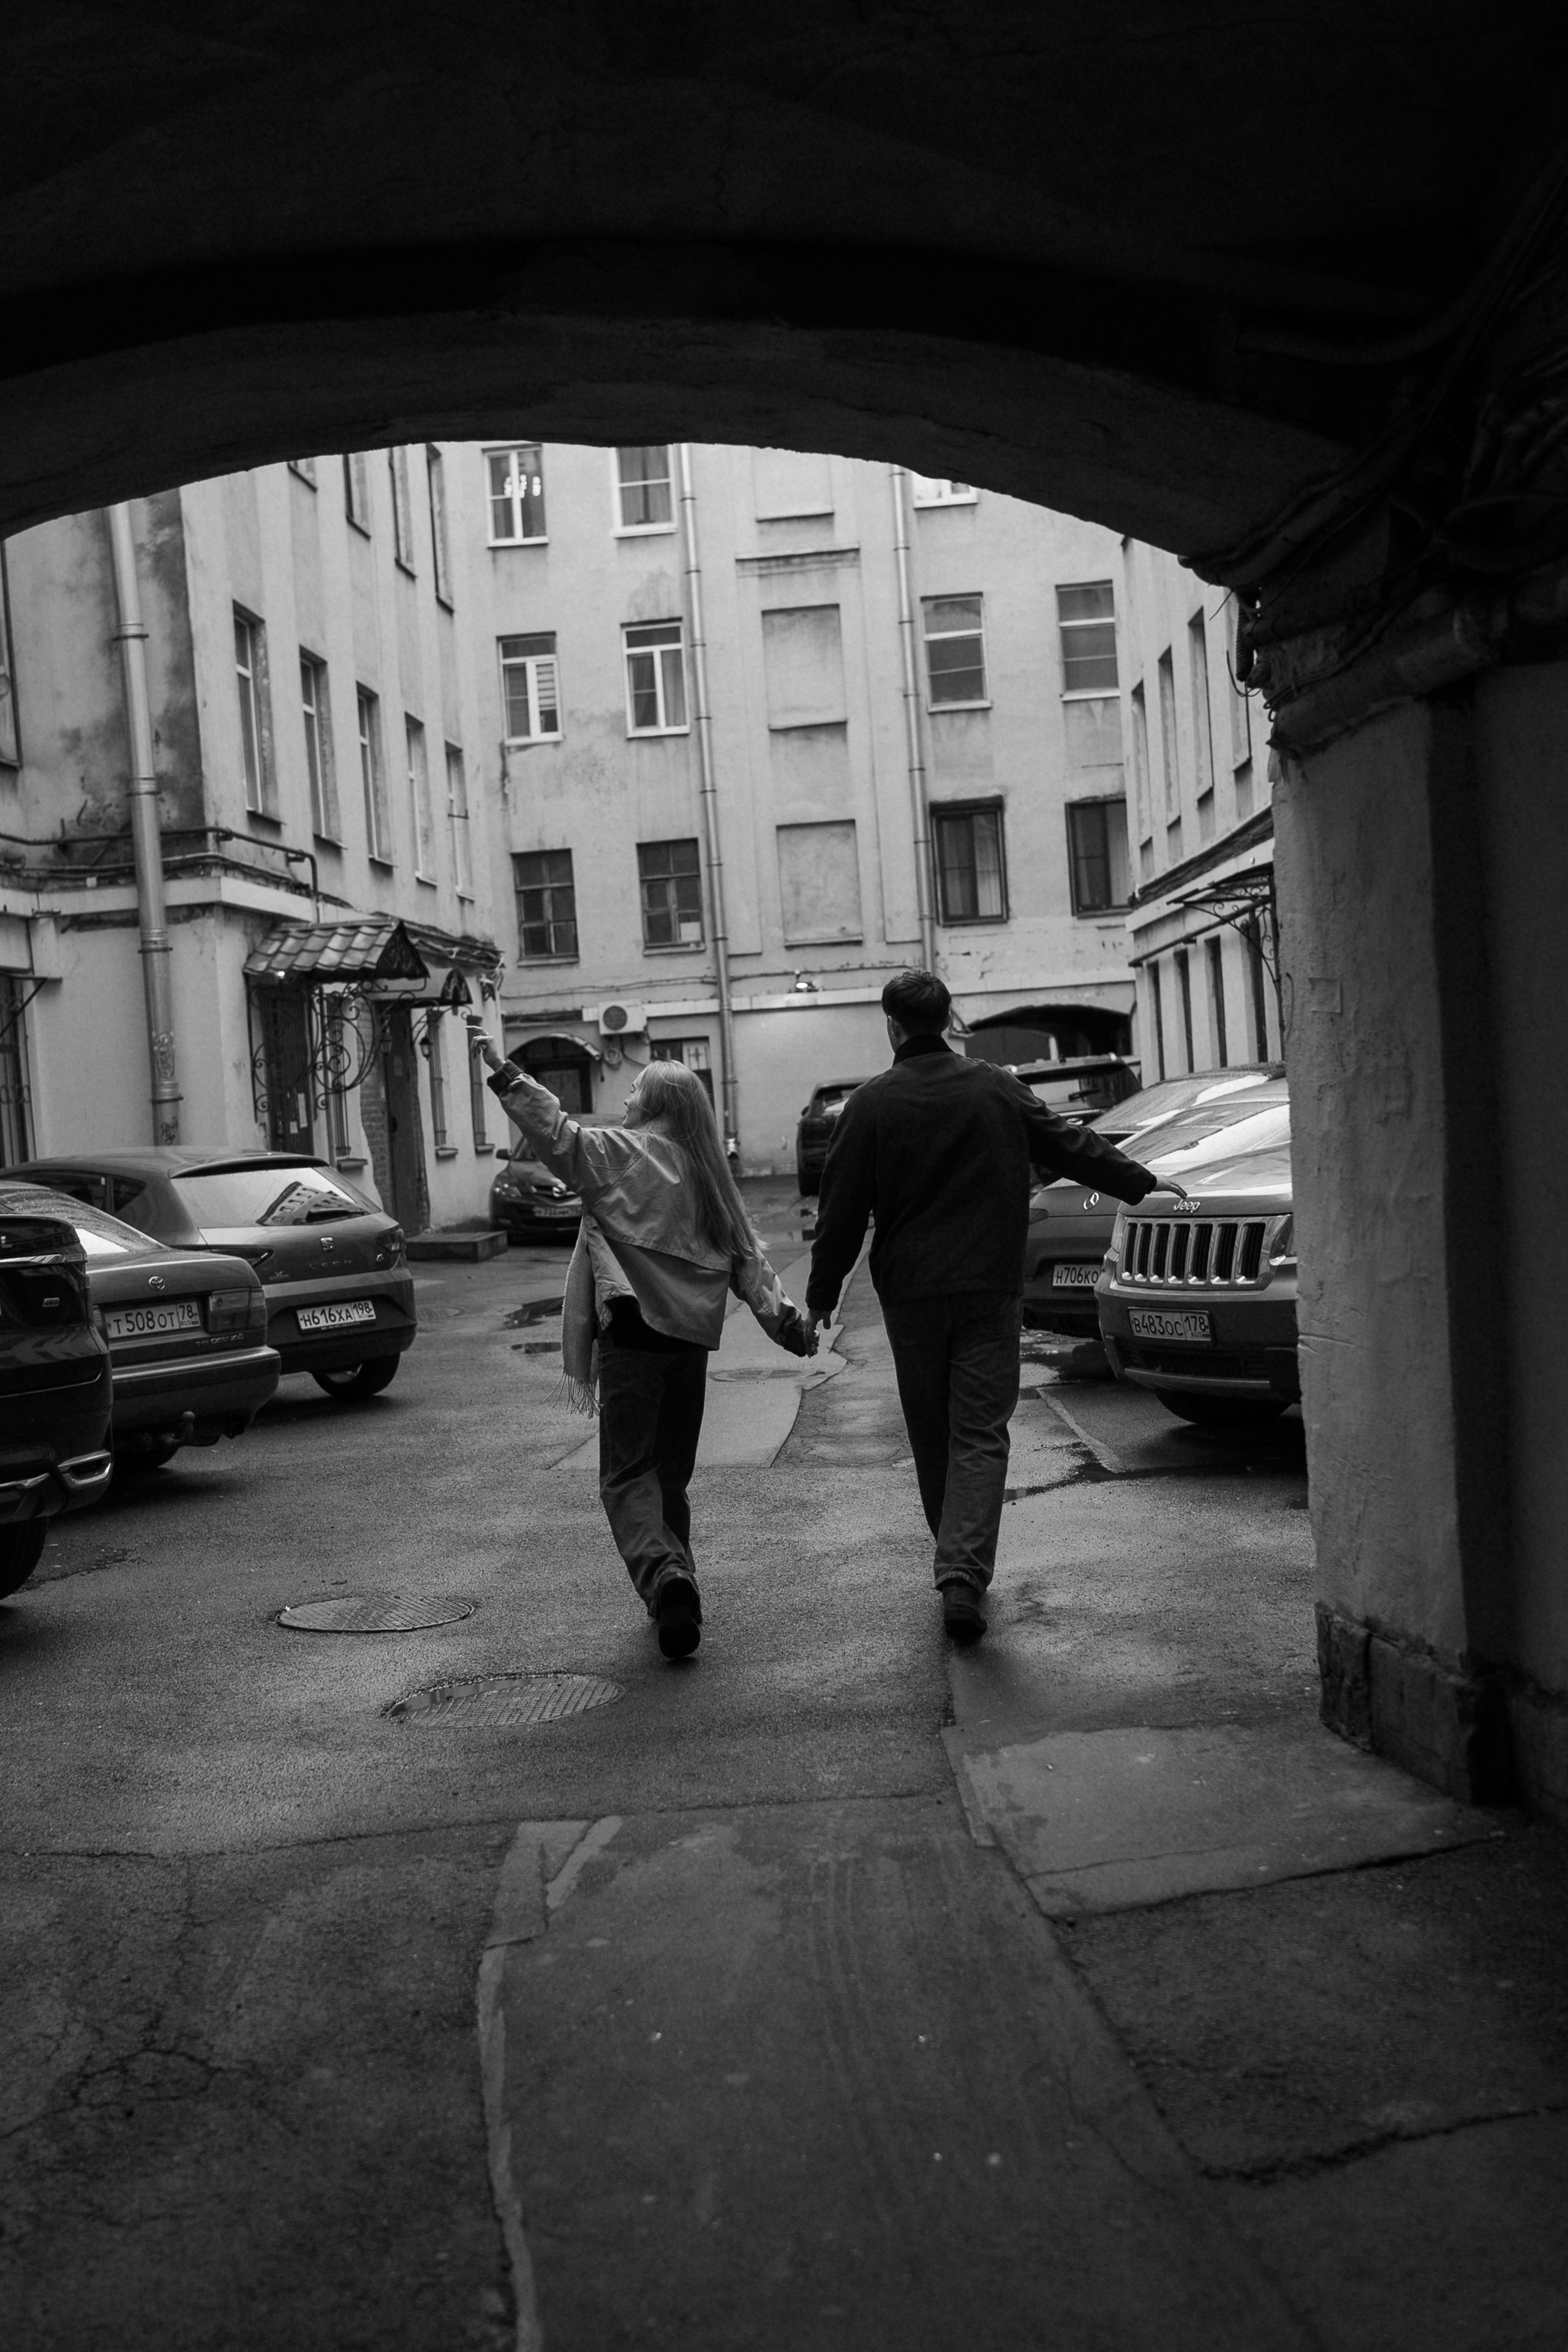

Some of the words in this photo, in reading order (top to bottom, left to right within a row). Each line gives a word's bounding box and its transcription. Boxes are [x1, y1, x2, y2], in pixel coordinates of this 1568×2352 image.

[1172, 1199, 1200, 1213] Jeep
[1056, 1267, 1099, 1284] Н706КО
[113, 1310, 175, 1334] Т508ОТ
[179, 1304, 194, 1320] 78
[303, 1307, 353, 1327] Н616ХА
[353, 1302, 371, 1315] 198
[1133, 1314, 1183, 1336] В483ОС
[1184, 1316, 1206, 1331] 178
